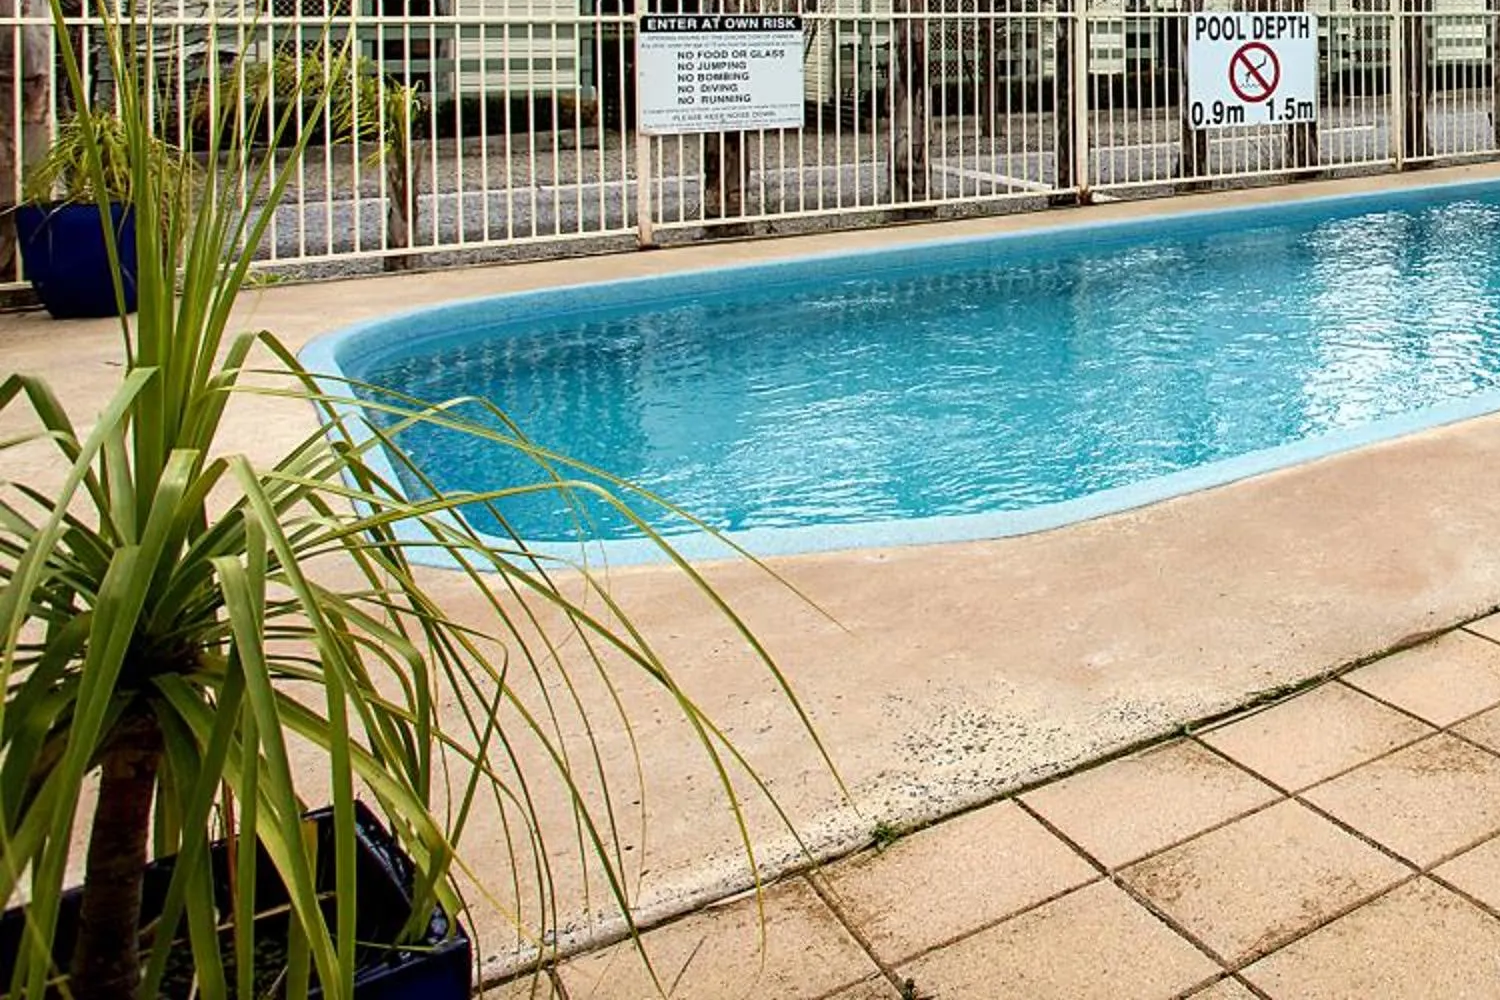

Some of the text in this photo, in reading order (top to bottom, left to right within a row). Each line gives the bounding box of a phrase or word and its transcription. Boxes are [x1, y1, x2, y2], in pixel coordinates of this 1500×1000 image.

[647, 17, 796, 31] ENTER AT OWN RISK
[1195, 16, 1310, 41] POOL DEPTH
[678, 49, 785, 60] NO FOOD OR GLASS
[678, 61, 747, 71] NO JUMPING
[678, 72, 750, 82] NO BOMBING
[678, 83, 738, 93] NO DIVING
[678, 94, 751, 104] NO RUNNING
[1191, 98, 1313, 126] 0.9m 1.5m
